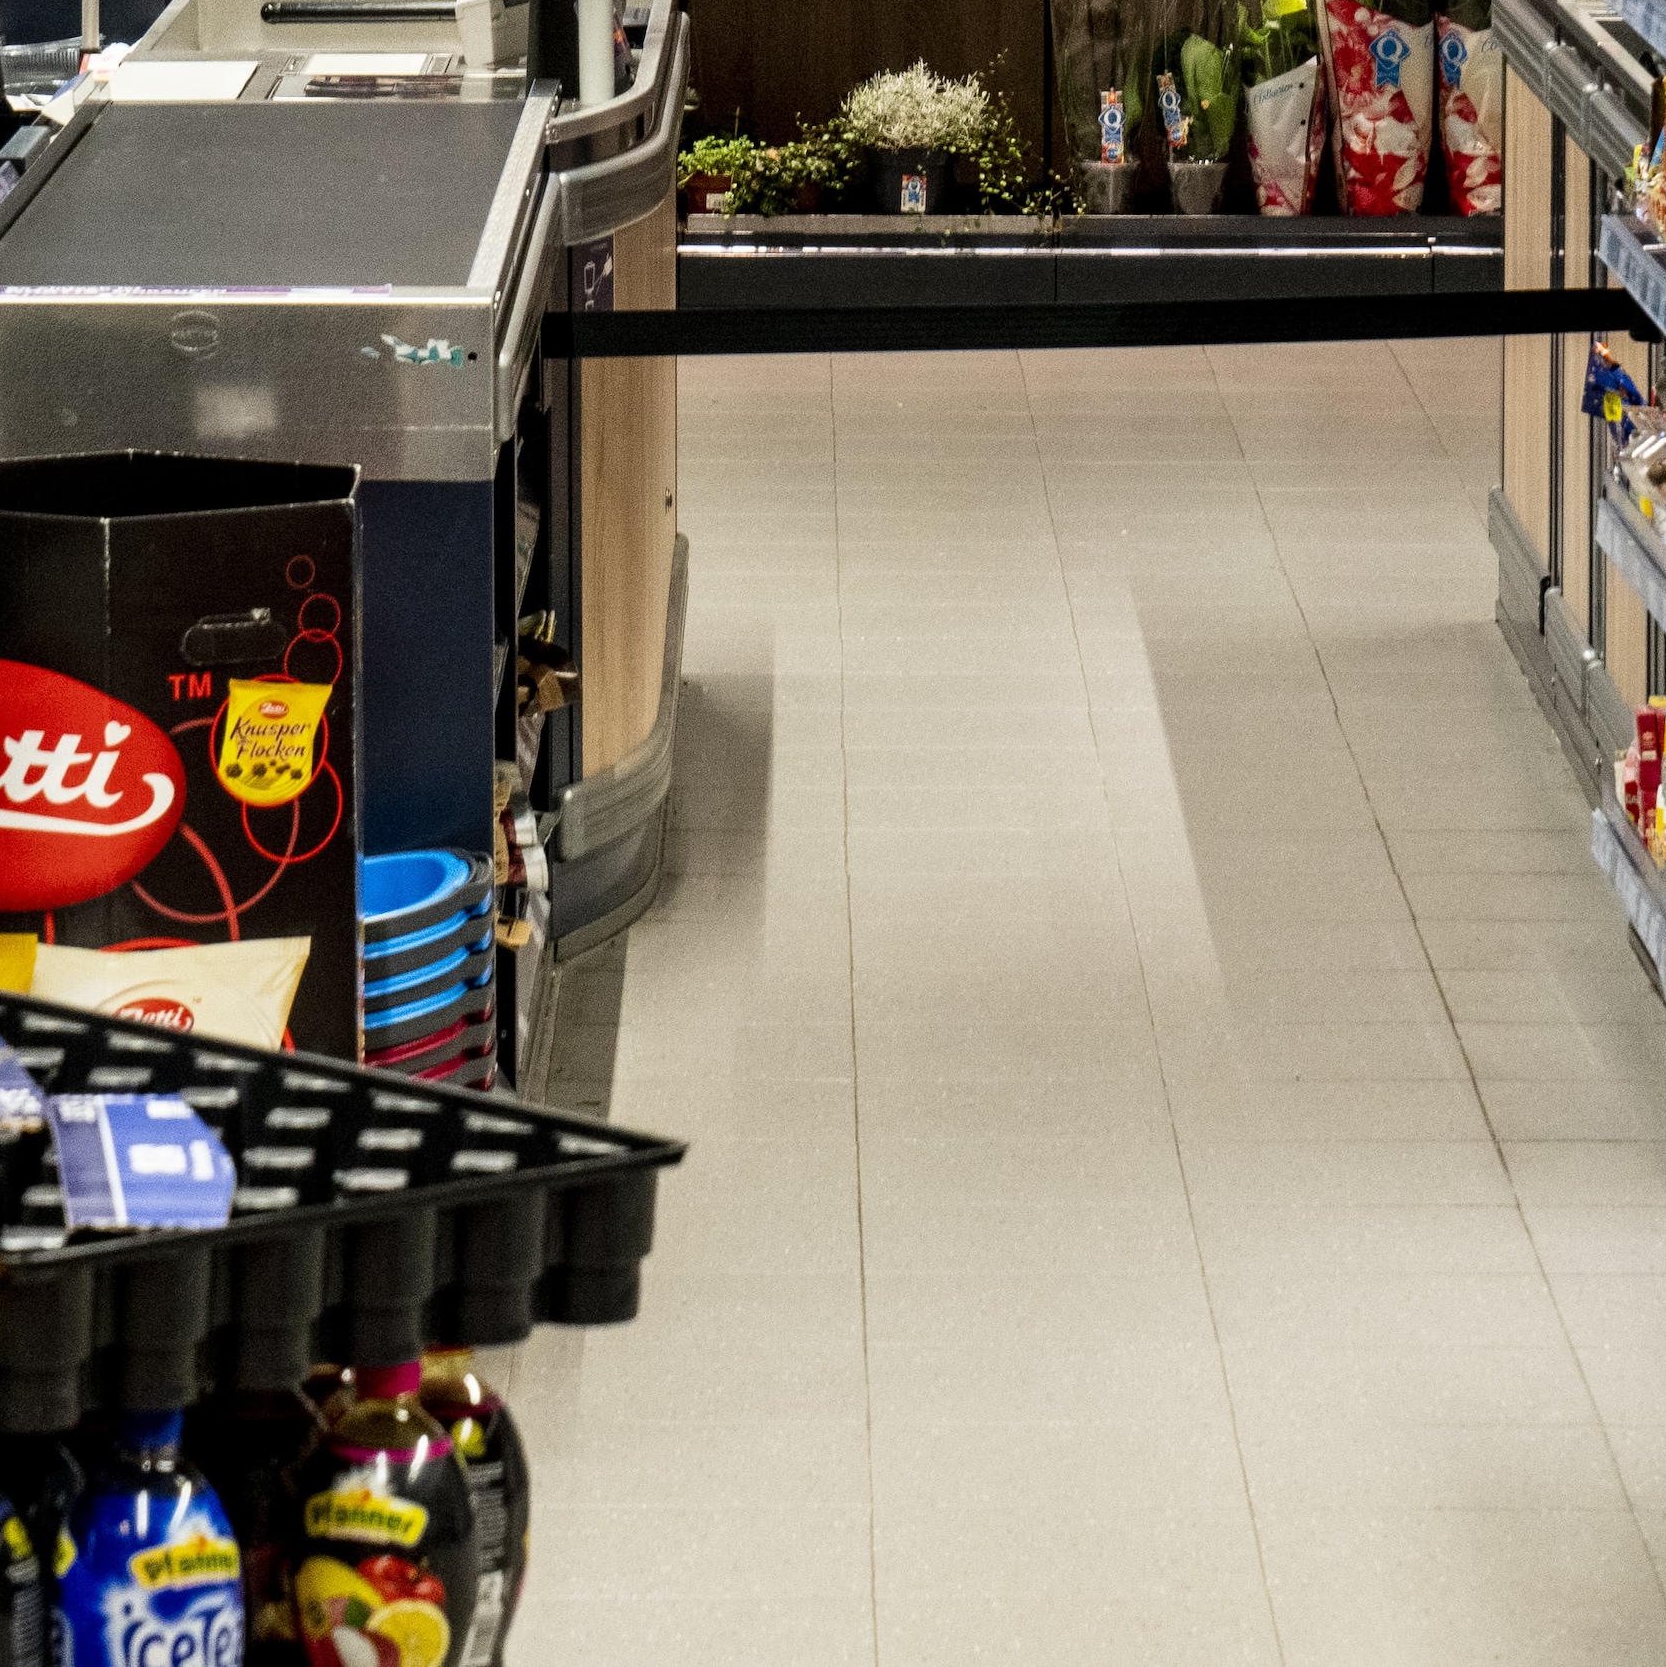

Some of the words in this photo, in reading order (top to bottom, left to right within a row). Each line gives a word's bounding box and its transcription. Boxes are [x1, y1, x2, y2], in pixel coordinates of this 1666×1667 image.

[167, 671, 214, 701] TM
[230, 716, 312, 741] Knusper
[236, 738, 306, 761] Flocken
